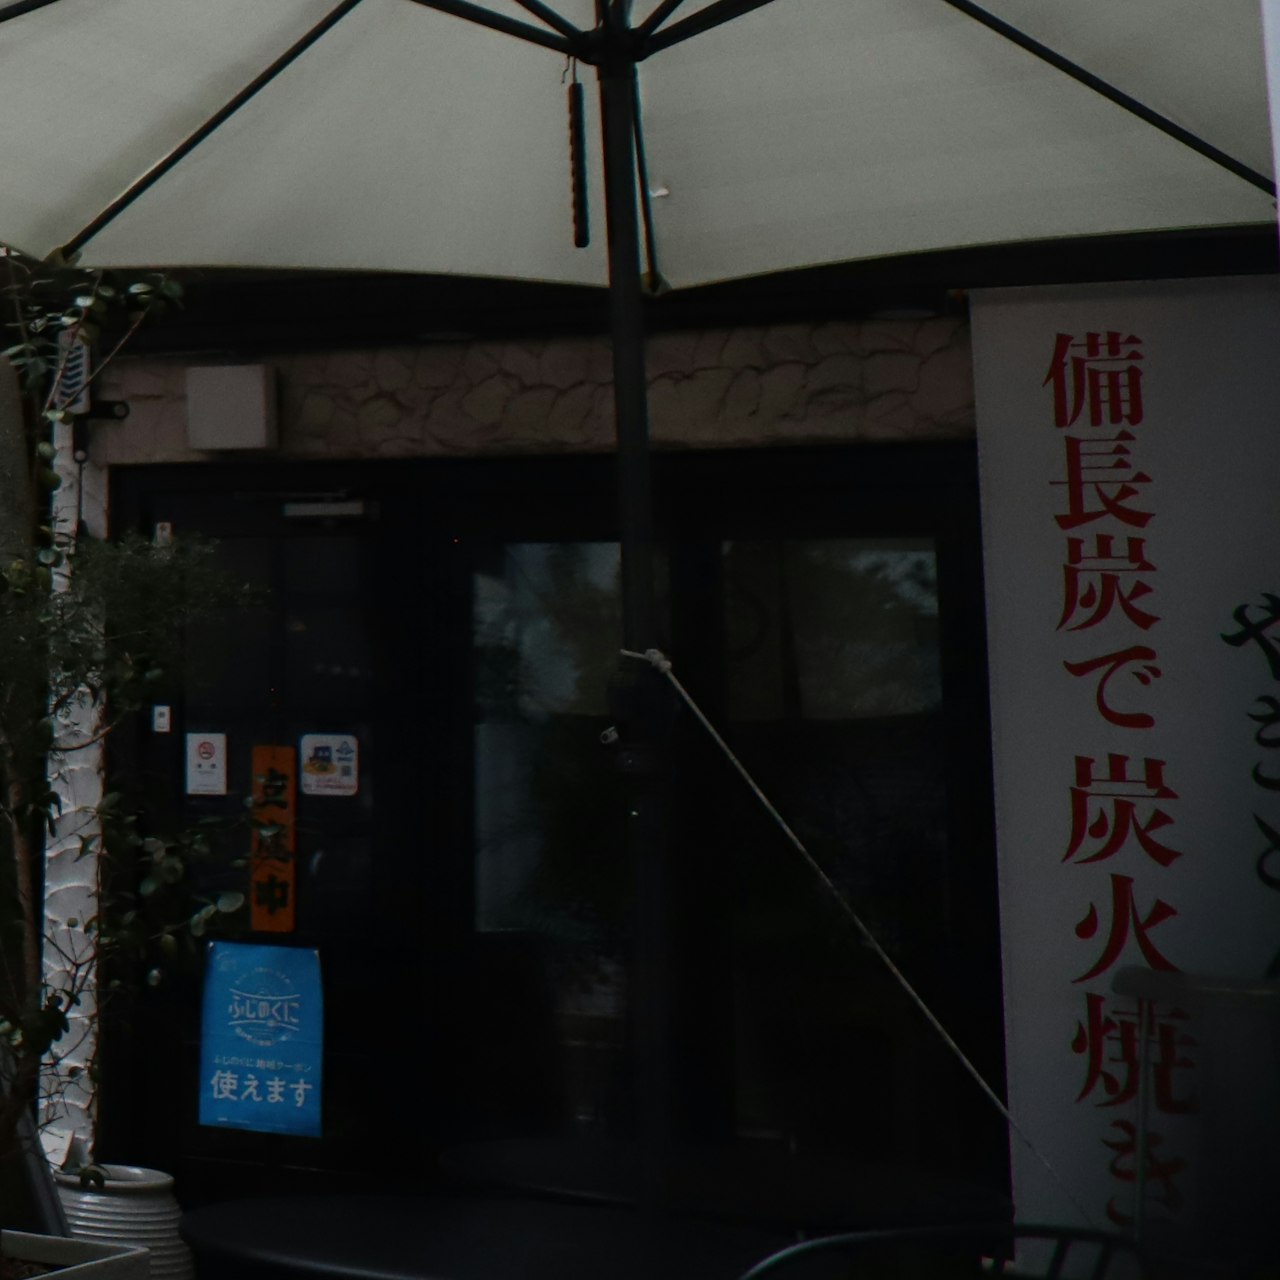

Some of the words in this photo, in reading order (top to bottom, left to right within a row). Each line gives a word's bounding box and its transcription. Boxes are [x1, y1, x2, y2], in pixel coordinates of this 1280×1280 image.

[227, 994, 300, 1024] ふじのくに
[209, 1068, 314, 1109] 使えます
